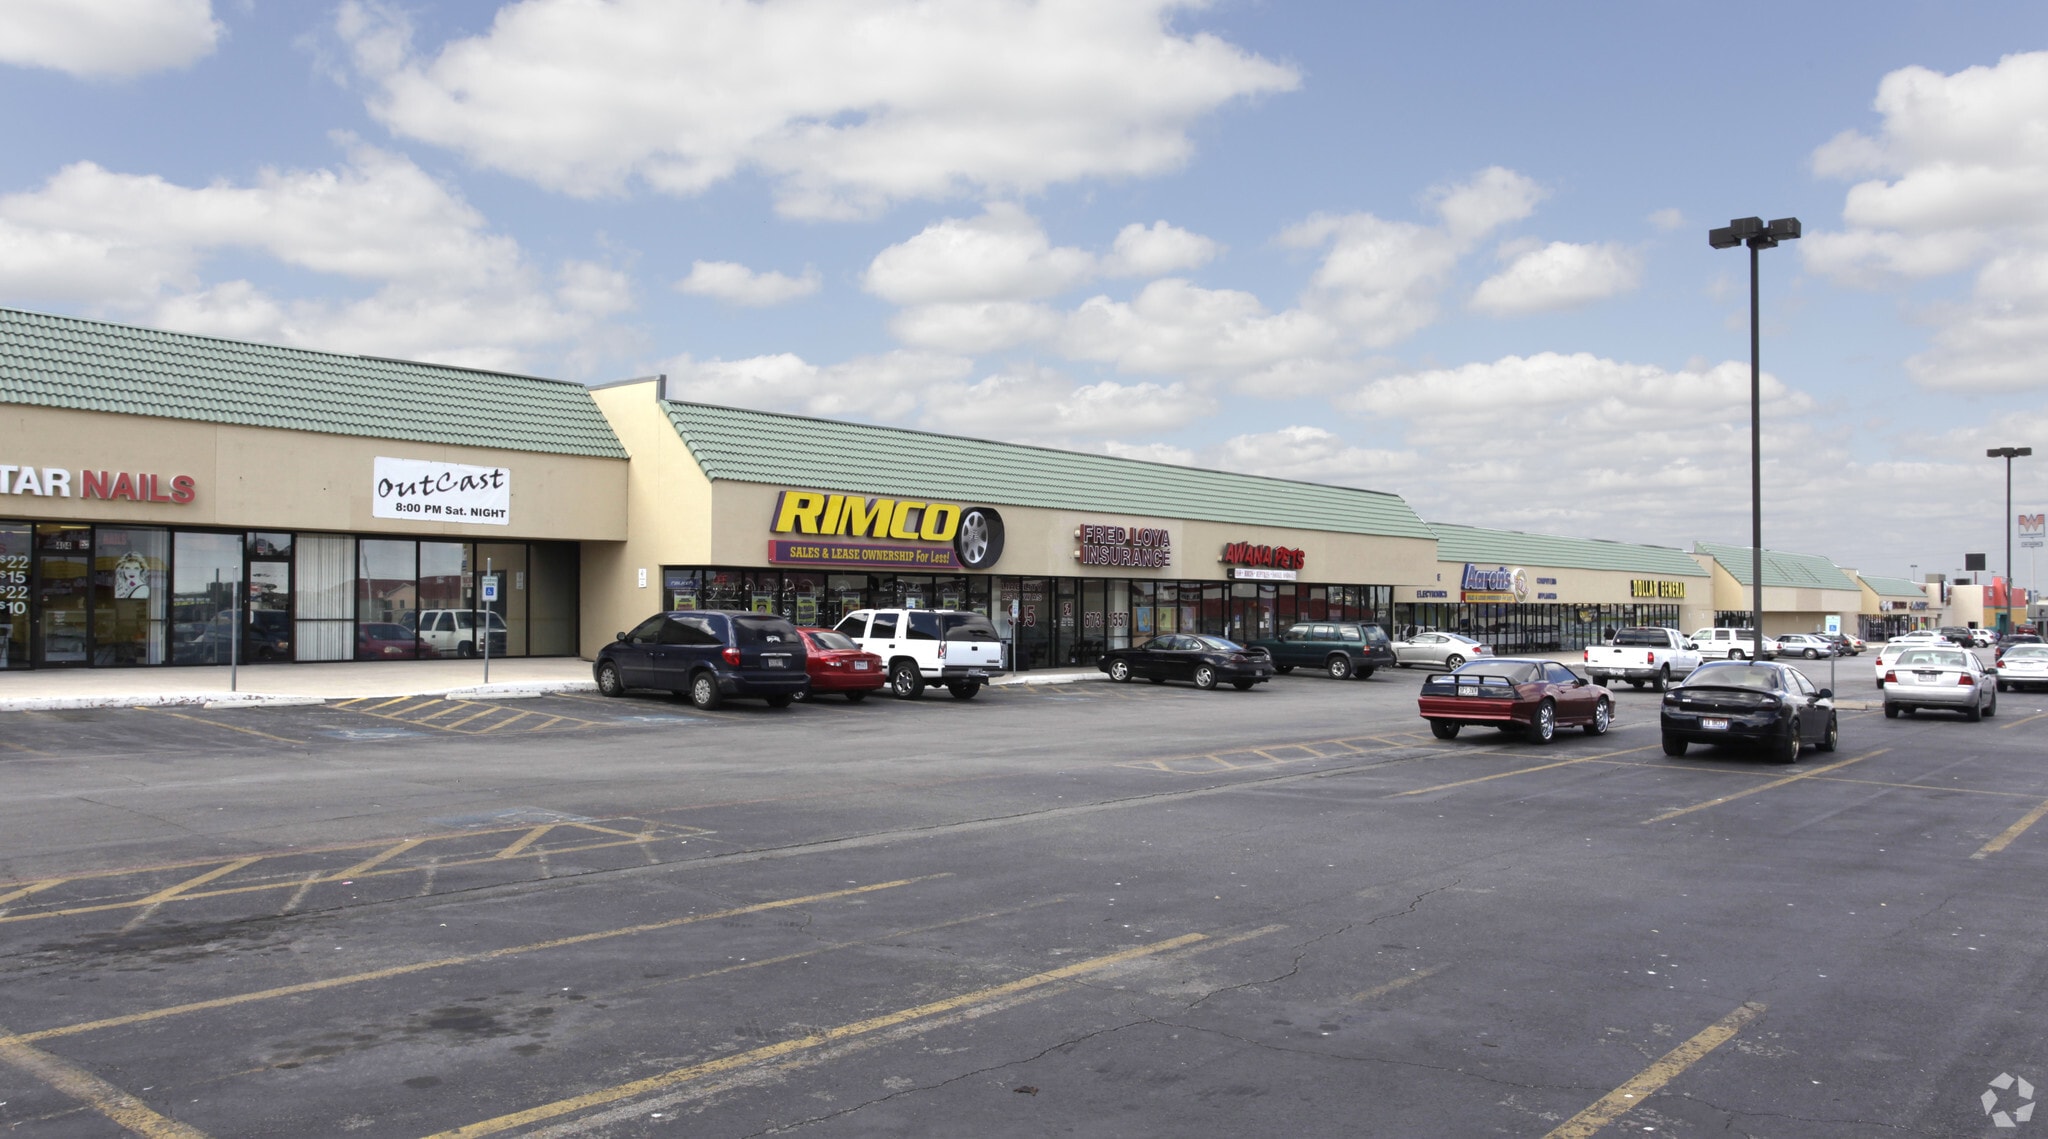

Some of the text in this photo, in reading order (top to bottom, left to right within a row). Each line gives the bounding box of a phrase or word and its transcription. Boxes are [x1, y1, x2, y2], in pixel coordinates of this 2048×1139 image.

[0, 465, 195, 504] TAR NAILS
[378, 468, 504, 498] OutCast
[395, 502, 506, 518] 8:00 PM Sat. NIGHT
[771, 490, 961, 541] RIMCO
[1081, 524, 1170, 548] FRED LOYA
[790, 546, 950, 564] SALES & LEASE OWNERSHIP For Less!
[1081, 545, 1171, 568] INSURANCE
[1224, 541, 1305, 570] AWANA PETS
[1462, 563, 1511, 590] Aaron's
[1631, 580, 1687, 598] DOLLAR GENERAL
